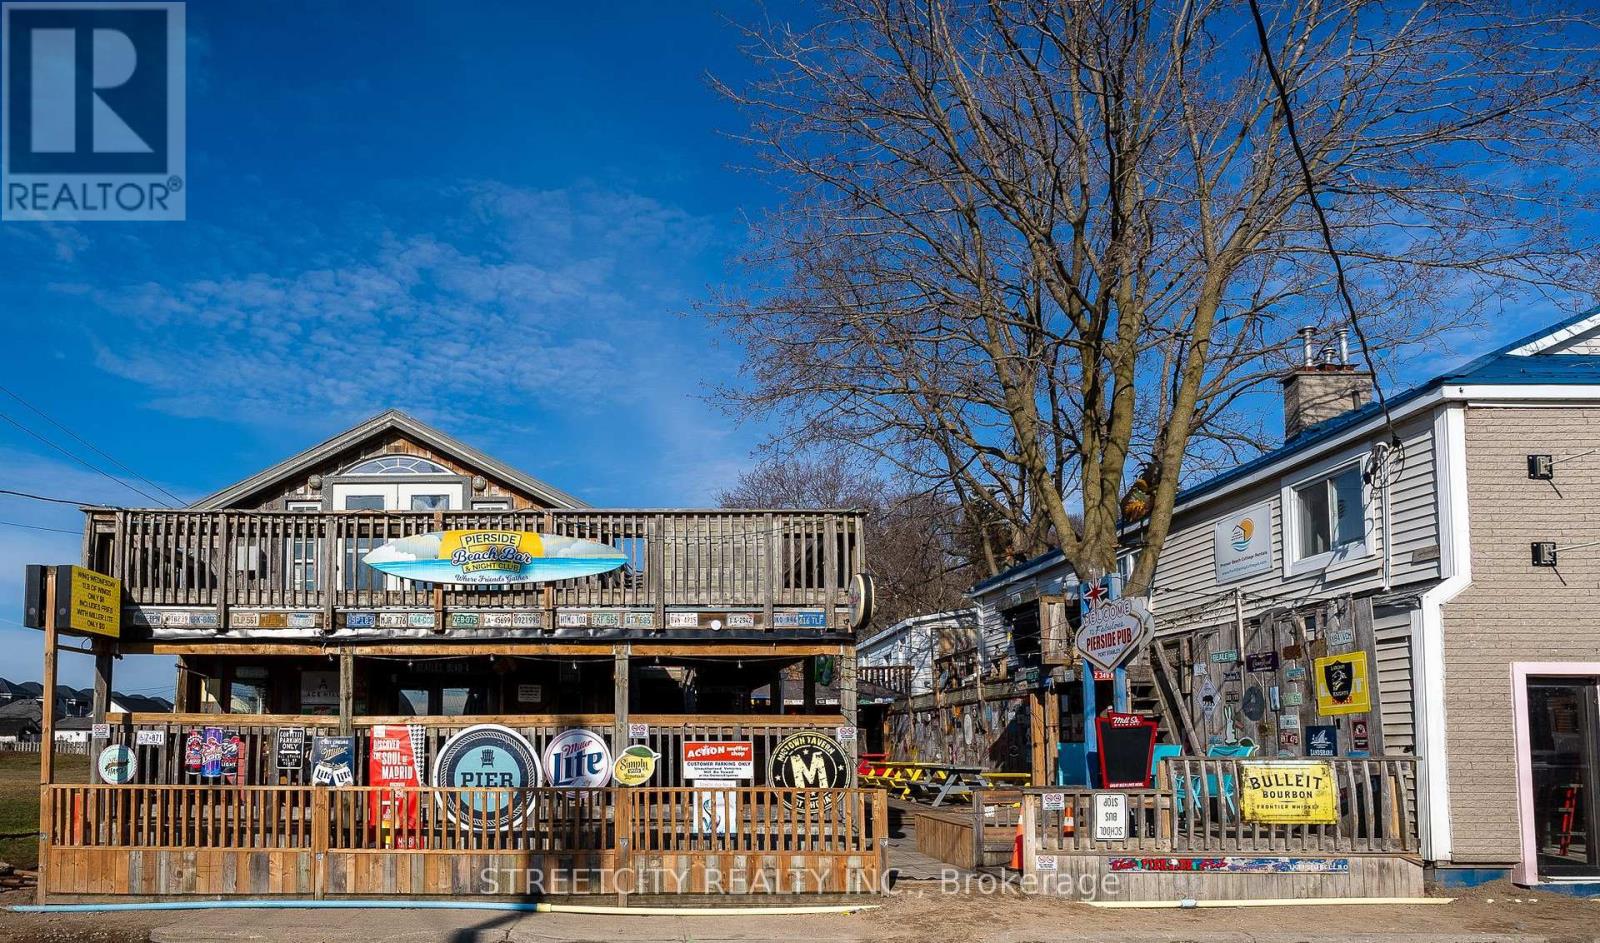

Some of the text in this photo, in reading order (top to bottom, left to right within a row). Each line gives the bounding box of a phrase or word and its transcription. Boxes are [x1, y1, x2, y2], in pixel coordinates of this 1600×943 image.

[465, 533, 516, 545] PIERSIDE
[452, 545, 532, 565] Beach Bar
[498, 562, 519, 571] CLUB
[455, 574, 528, 583] Where Friends Gather
[88, 592, 99, 601] ONLY
[77, 607, 88, 617] WITH
[1083, 600, 1130, 626] WELCOME
[1096, 621, 1125, 635] Fabulous
[1086, 627, 1132, 652] PIERSIDE PUB
[374, 739, 400, 751] DISCOVER
[562, 739, 593, 756] Miller
[687, 745, 725, 758] ACTION
[777, 736, 836, 762] MOTOWN TAVERN
[382, 751, 400, 766] SOUL
[619, 758, 649, 773] Simply
[381, 765, 413, 780] MADRID
[553, 748, 604, 787] Lite
[790, 751, 829, 788] M
[461, 772, 515, 787] PIER
[1249, 773, 1323, 790] BULLEIT
[1262, 790, 1313, 799] BOURBON
[1103, 797, 1119, 807] STOP
[1105, 812, 1118, 821] BUS
[1099, 826, 1123, 836] SCHOOL
